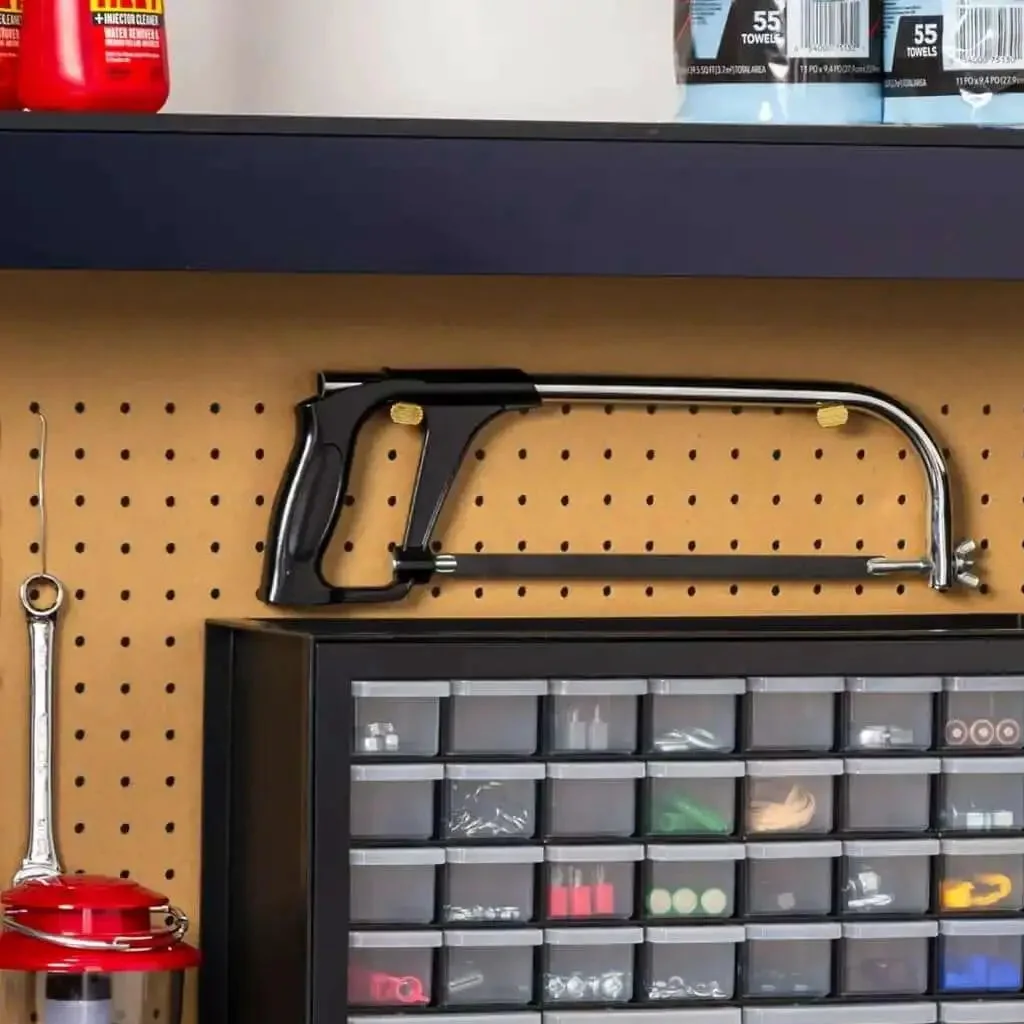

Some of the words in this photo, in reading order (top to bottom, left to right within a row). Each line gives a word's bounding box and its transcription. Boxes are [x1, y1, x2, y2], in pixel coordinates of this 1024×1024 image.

[136, 14, 159, 26] CLEANER
[753, 11, 781, 31] 55
[741, 33, 782, 45] TOWELS
[914, 23, 938, 45] 55
[907, 46, 938, 57] TOWELS
